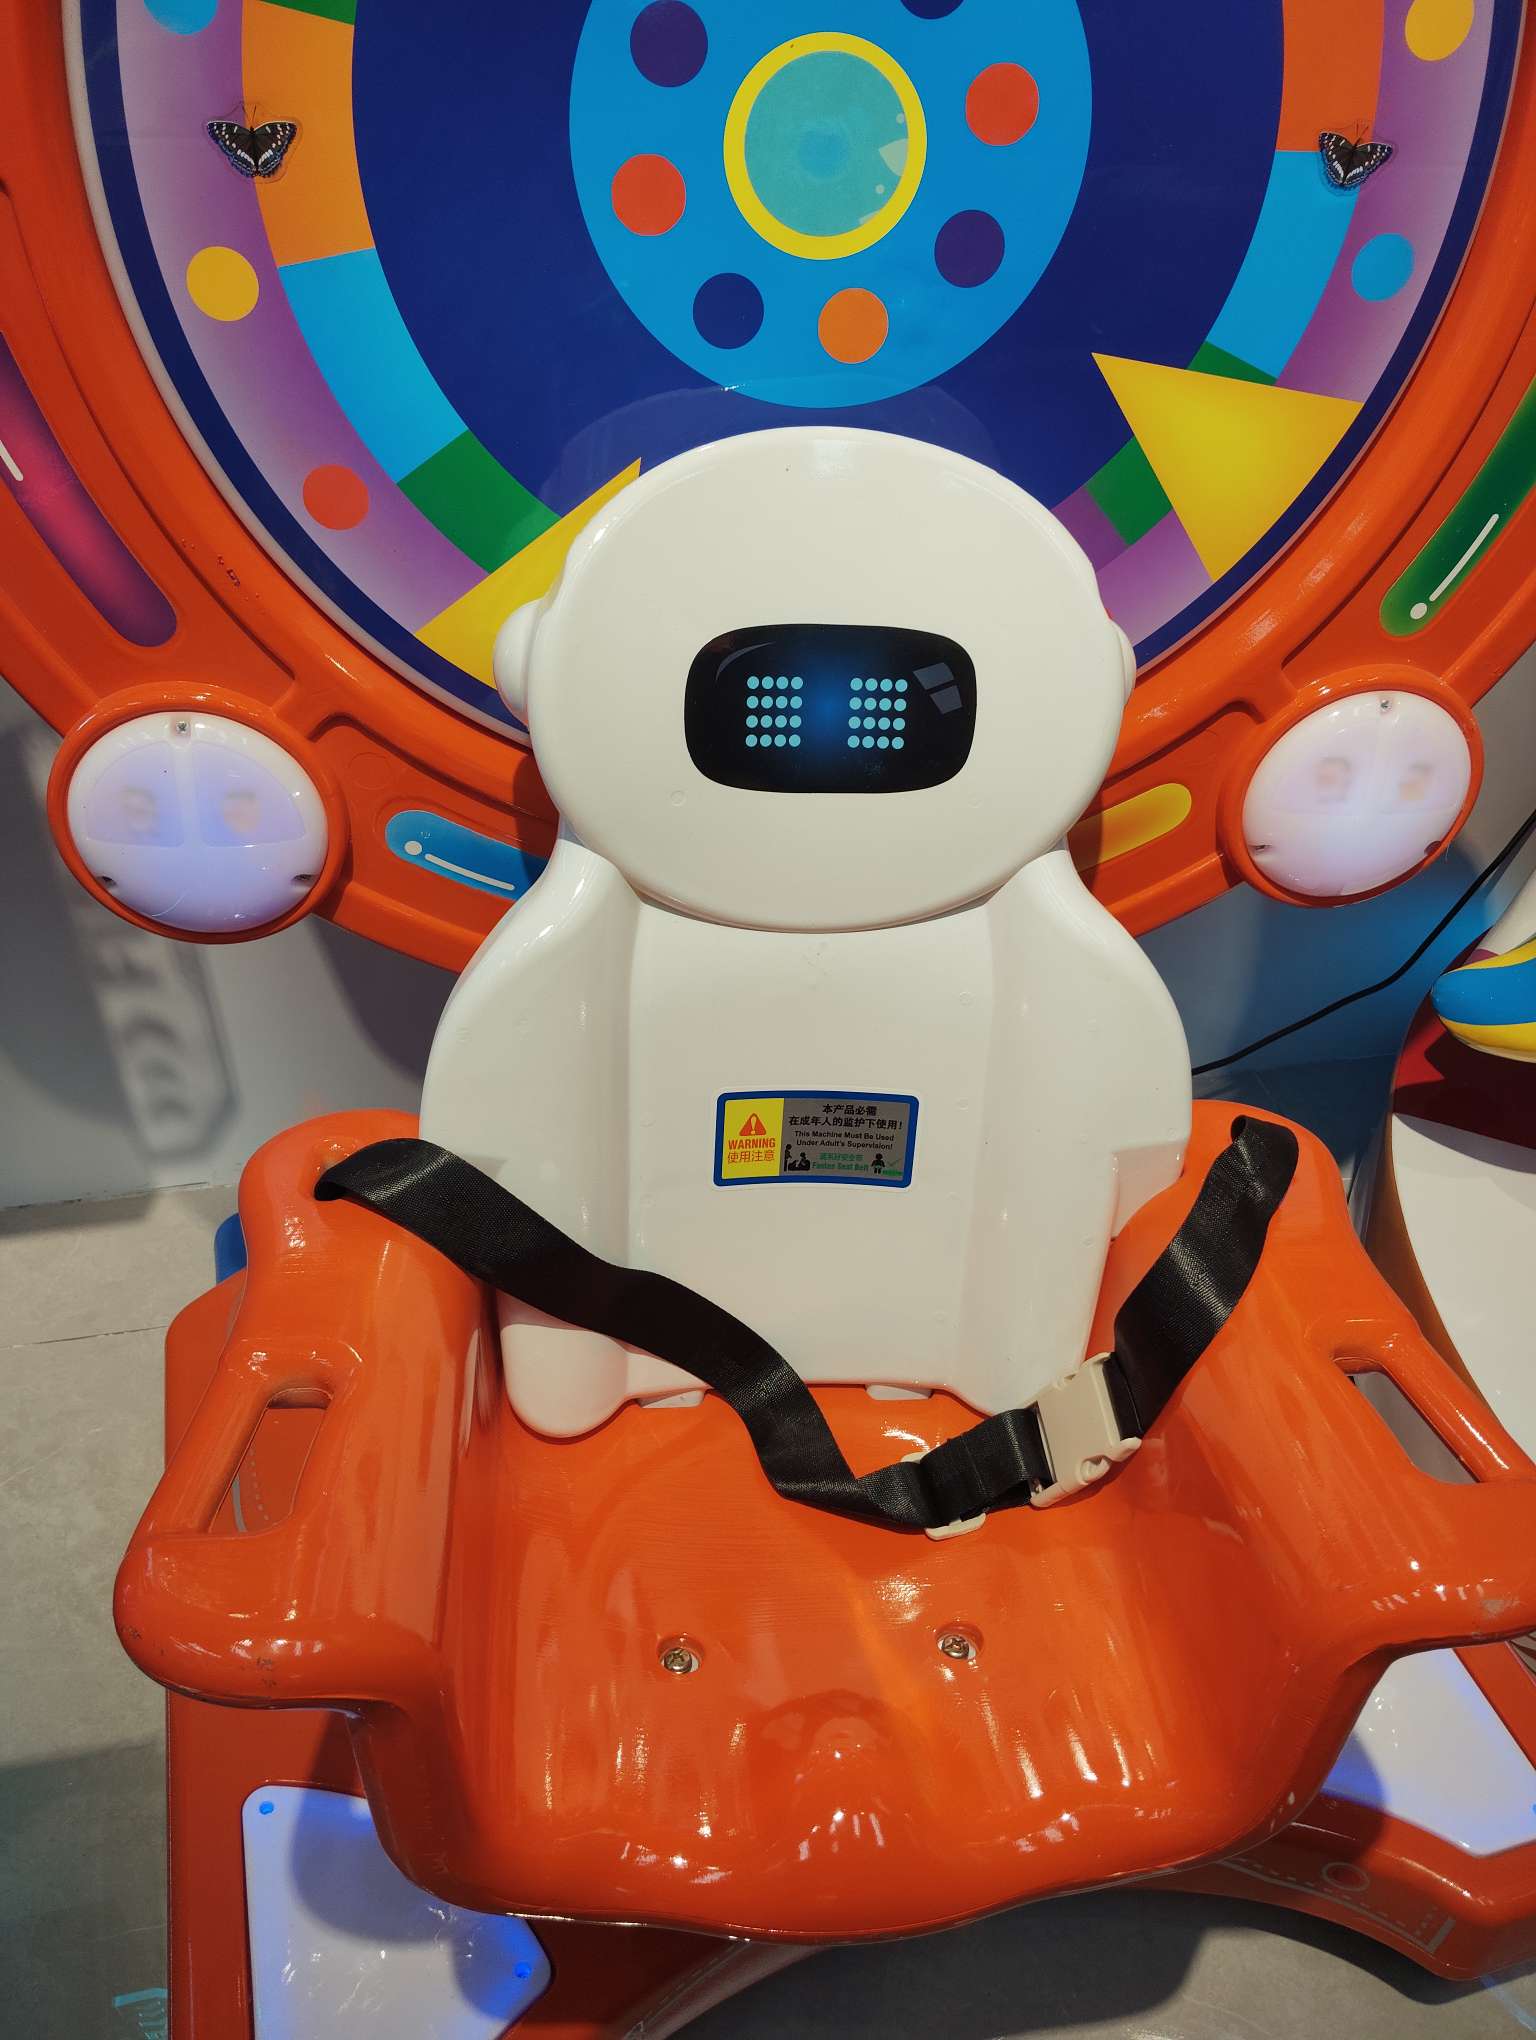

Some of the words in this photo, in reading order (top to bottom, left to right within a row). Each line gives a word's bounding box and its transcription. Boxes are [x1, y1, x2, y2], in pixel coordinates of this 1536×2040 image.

[822, 1103, 877, 1116] 本产品必需
[794, 1130, 810, 1138] This
[812, 1131, 842, 1139] Machine
[844, 1131, 862, 1140] Must
[875, 1134, 894, 1142] Used
[728, 1138, 776, 1150] WARNING
[847, 1141, 893, 1150] Supervision!
[727, 1150, 775, 1164] 使用注意
